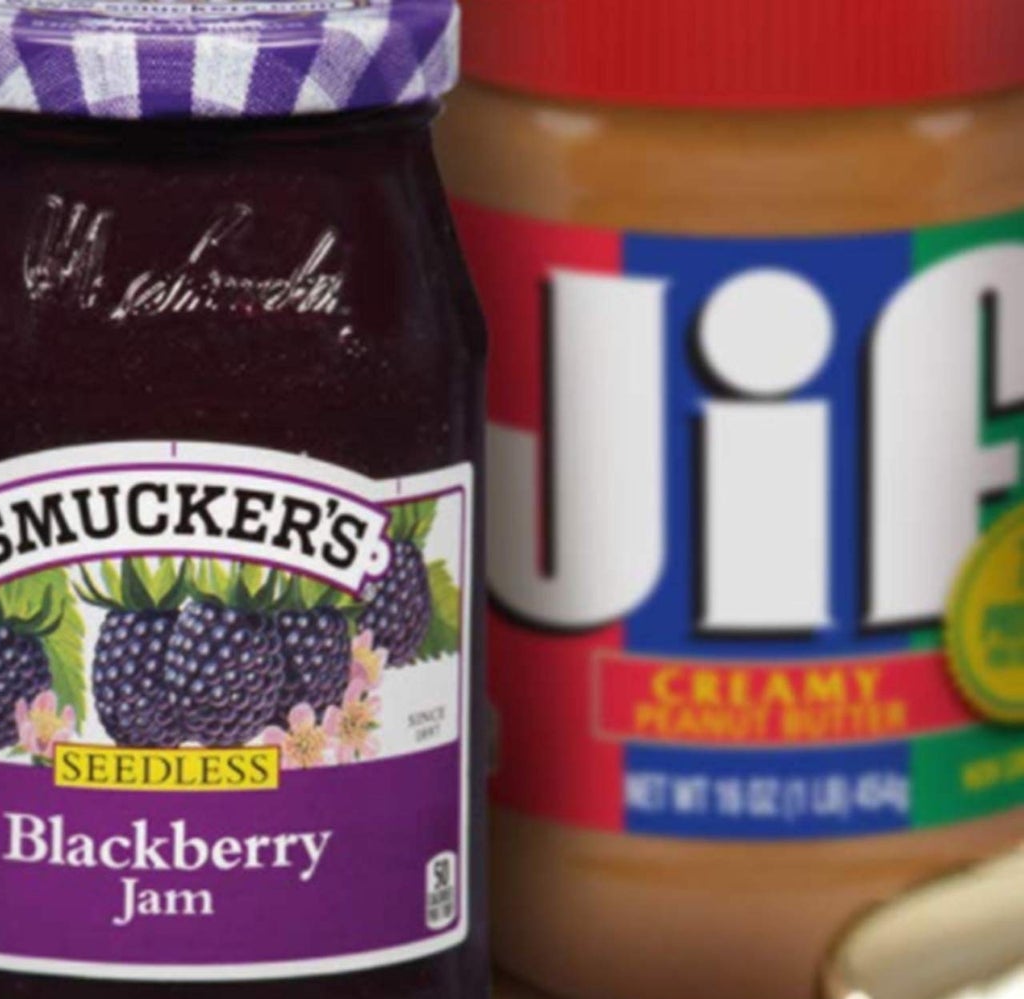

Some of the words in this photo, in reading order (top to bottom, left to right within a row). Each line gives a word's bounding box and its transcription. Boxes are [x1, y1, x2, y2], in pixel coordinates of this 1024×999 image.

[486, 242, 1024, 636] Jif
[652, 667, 880, 702] CREAMY
[61, 751, 272, 786] SEEDLESS
[3, 813, 333, 881] Blackberry
[112, 878, 215, 926] Jam
